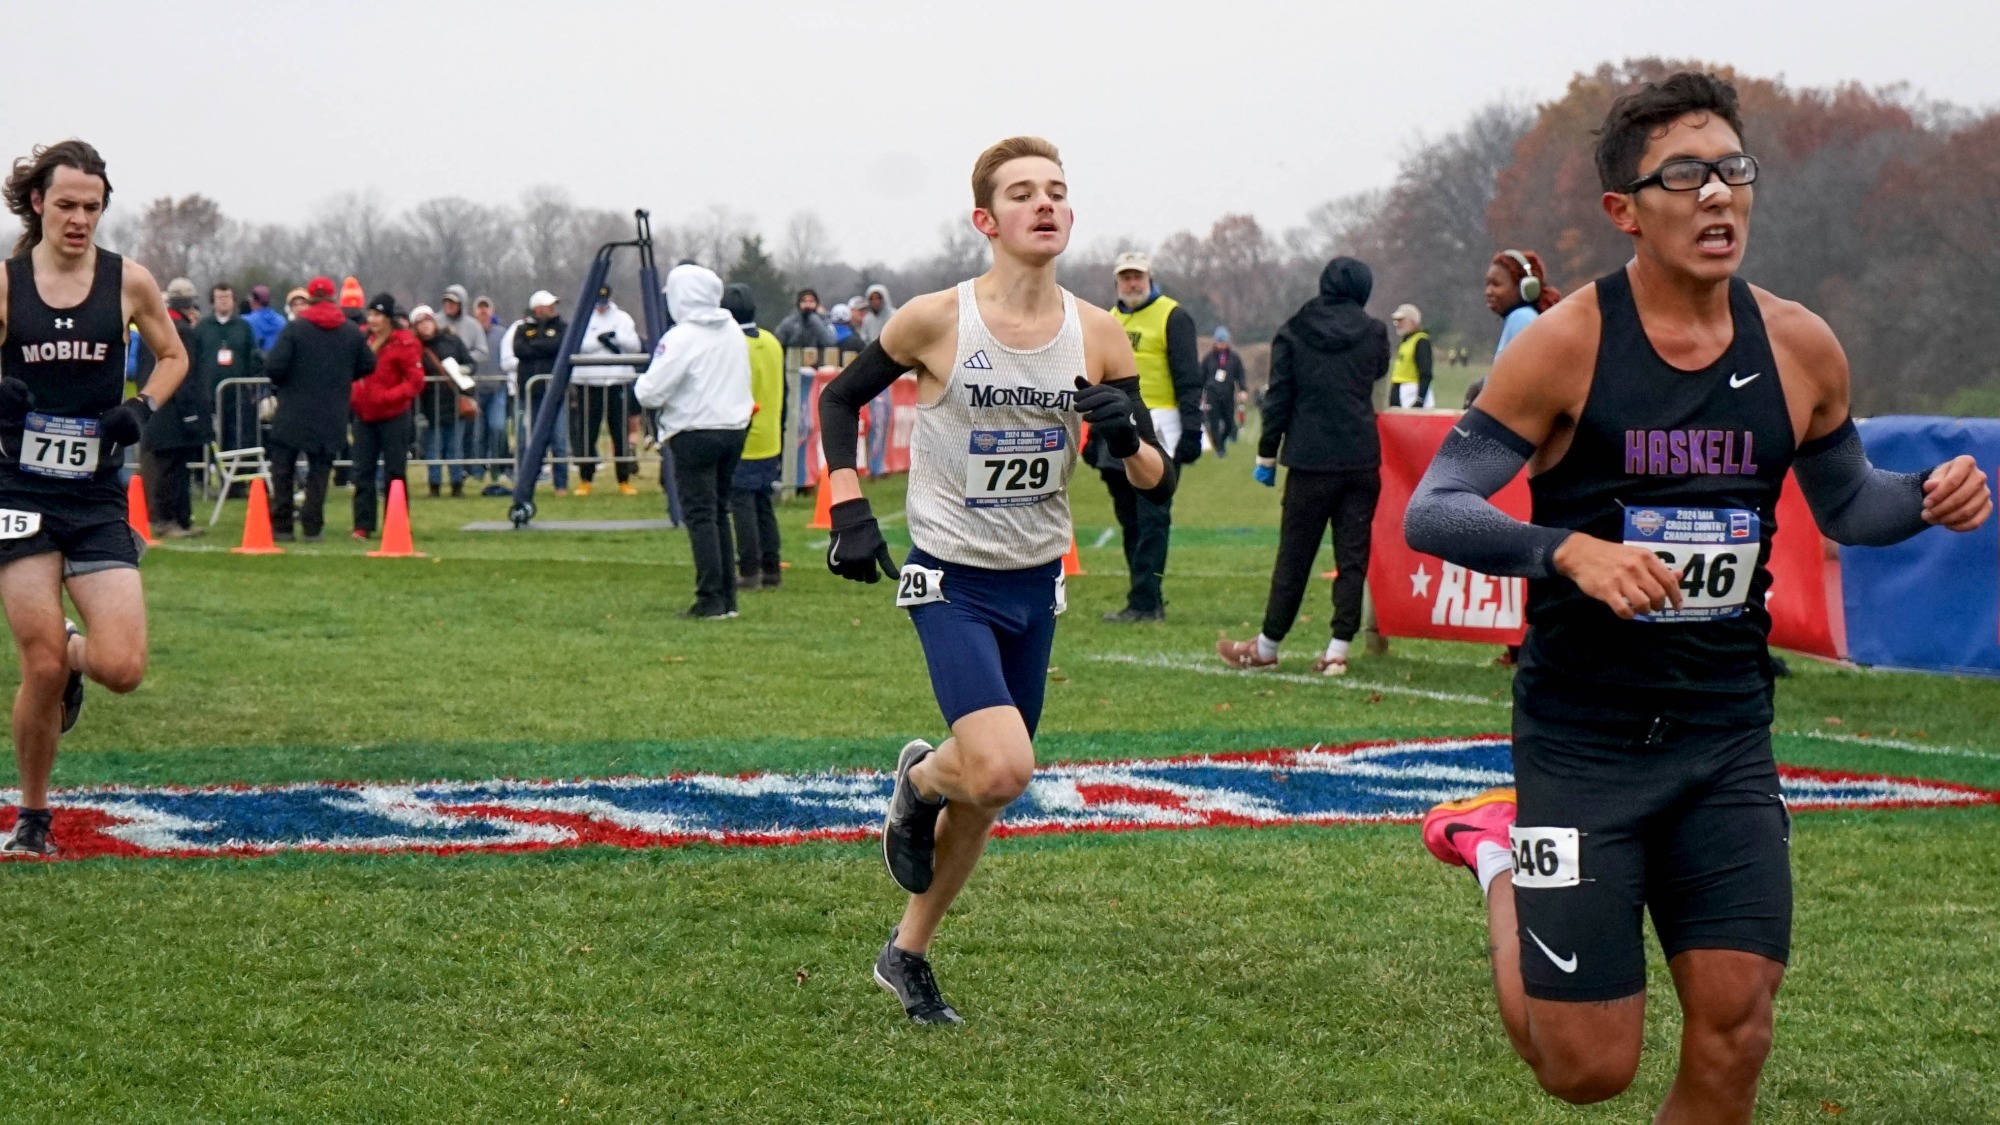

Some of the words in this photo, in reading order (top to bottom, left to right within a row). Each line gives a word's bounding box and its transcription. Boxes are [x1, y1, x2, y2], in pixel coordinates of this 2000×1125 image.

[21, 340, 108, 363] MOBILE
[964, 383, 1077, 412] MONTREAT
[35, 437, 87, 466] 715
[995, 445, 1041, 453] CHAMPIONSHIPS
[997, 438, 1016, 446] CROSS
[1016, 437, 1043, 445] COUNTRY
[1625, 429, 1758, 475] HASKELL
[984, 457, 1050, 491] 729
[2, 514, 27, 533] 15
[1665, 520, 1693, 530] CROSS
[1693, 521, 1727, 531] COUNTRY
[1676, 510, 1697, 520] 2024
[1663, 530, 1725, 542] CHAMPIONSHIPS
[1654, 551, 1738, 598] 46
[1431, 560, 1522, 629] RED
